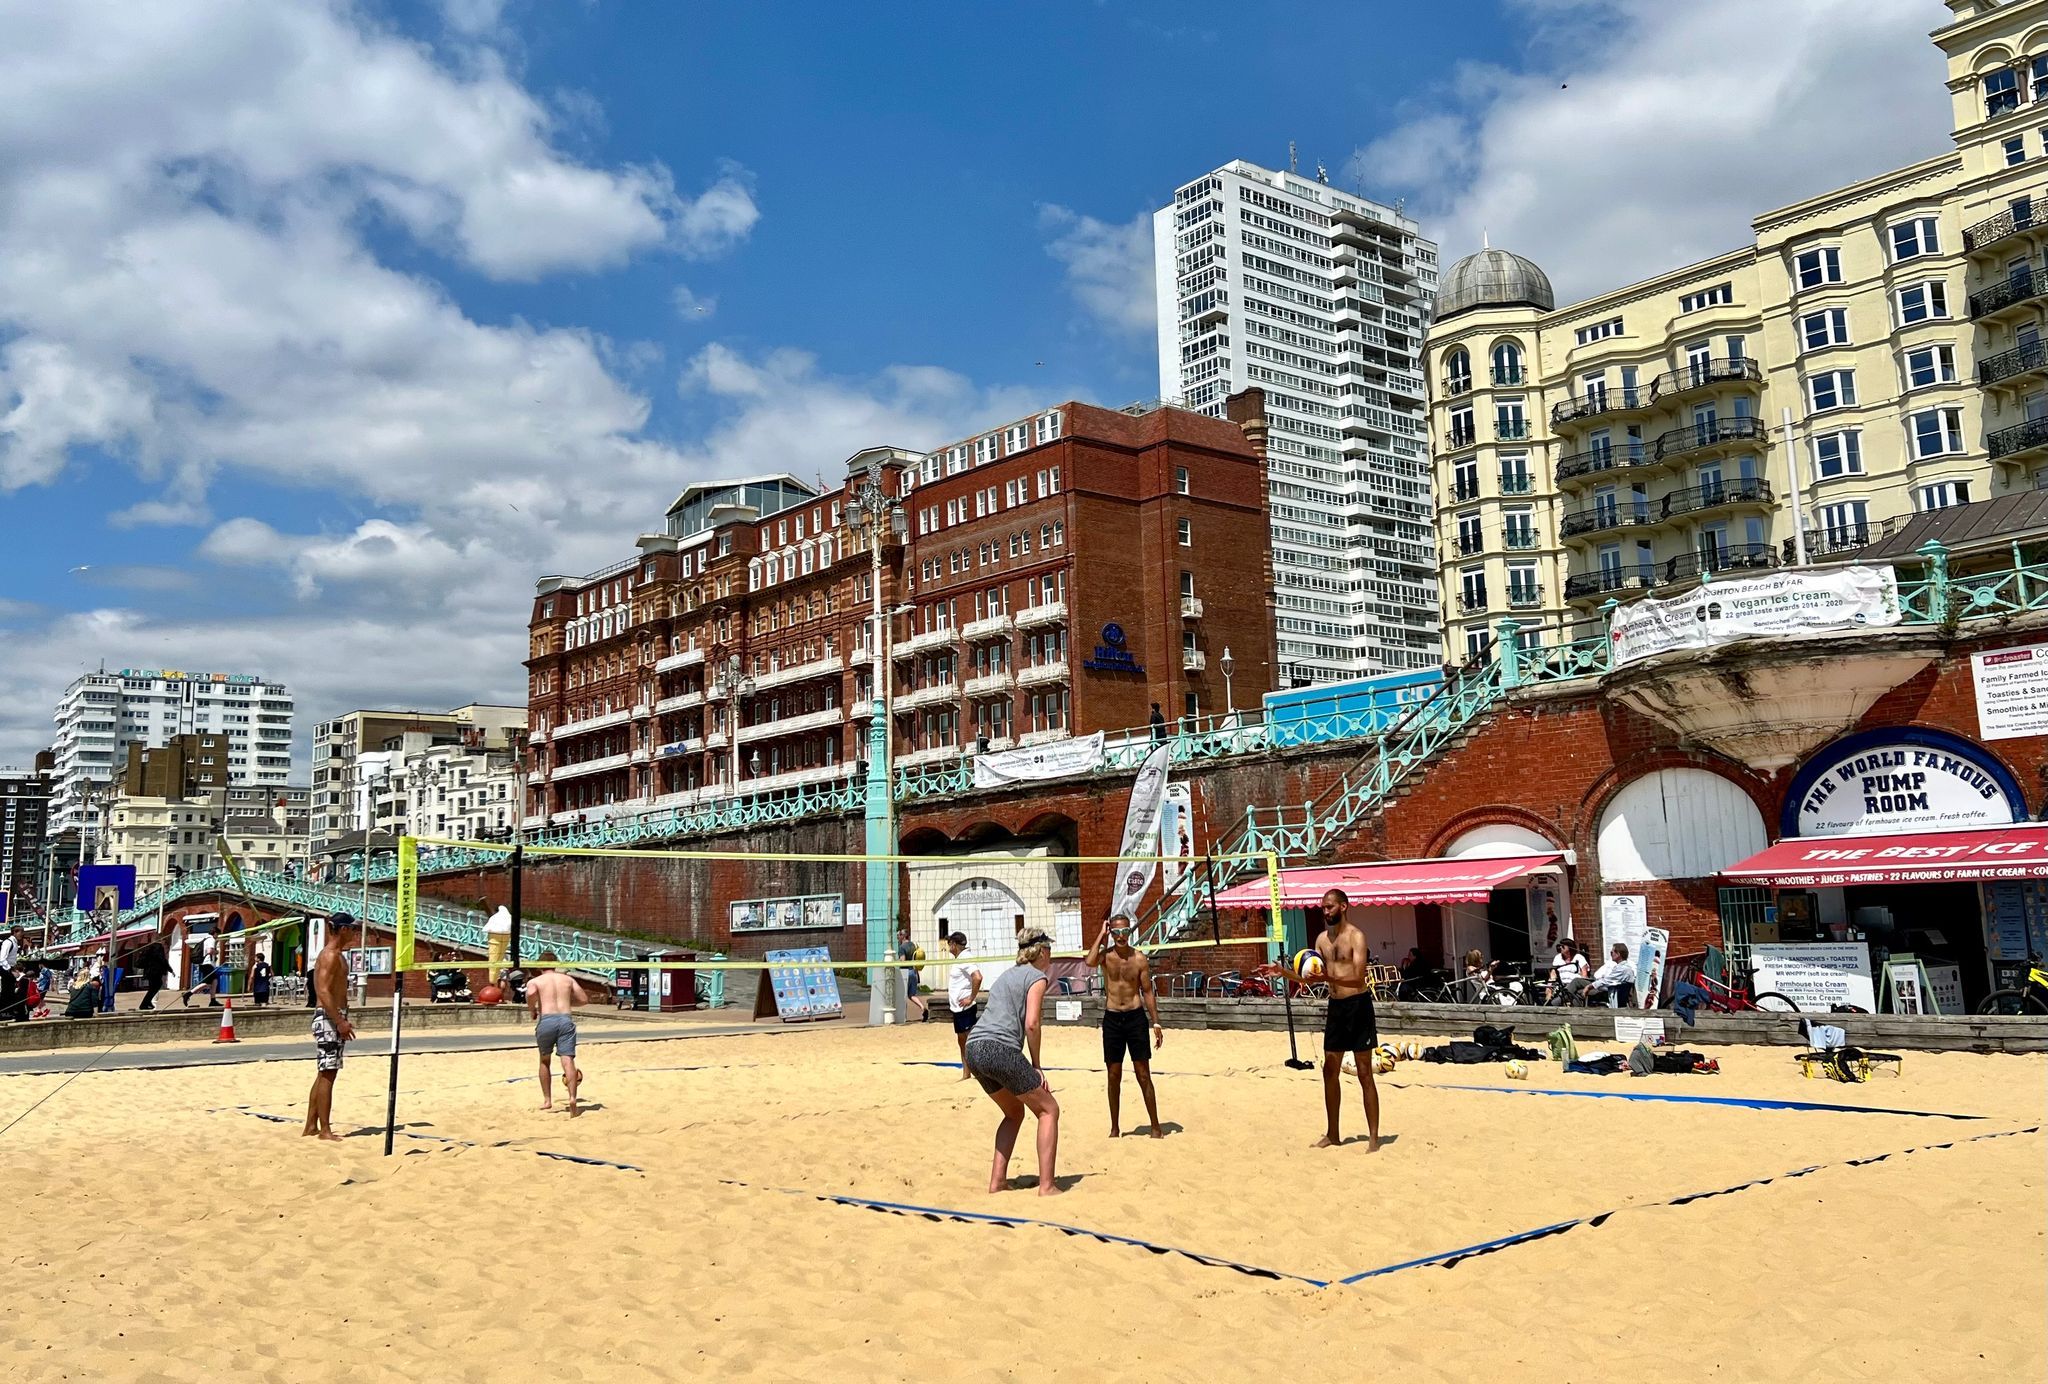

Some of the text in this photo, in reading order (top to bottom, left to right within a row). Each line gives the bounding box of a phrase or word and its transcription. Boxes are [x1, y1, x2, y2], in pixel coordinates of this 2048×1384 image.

[1741, 583, 1771, 594] BEACH
[1773, 580, 1785, 589] BY
[1786, 578, 1804, 587] FAR
[1732, 590, 1831, 610] Vegan Ice Cream
[1665, 611, 1692, 623] Cream
[1735, 610, 1754, 620] great
[1754, 606, 1773, 615] taste
[1774, 603, 1800, 613] awards
[1801, 601, 1819, 609] 2014
[1825, 599, 1844, 607] 2020
[1753, 618, 1791, 628] Sandwiches
[1094, 645, 1135, 662] Hilton
[1980, 676, 2007, 684] Family
[2008, 671, 2039, 680] Farmed
[1987, 689, 2020, 698] Toasties
[1986, 704, 2029, 715] Smoothies
[1803, 750, 1999, 815] THE WORLD FAMOUS
[1862, 771, 1927, 794] PUMP
[1864, 792, 1929, 815] ROOM
[1815, 810, 1988, 830] 22 flavours of farmhouse ice cream. Fresh coffee.
[1128, 829, 1158, 840] Vegan
[1123, 847, 1156, 857] Cream
[1133, 841, 1148, 849] Ice
[1800, 841, 2039, 861] THE BEST ICE
[1775, 876, 1815, 886] SMOOTHIES
[1820, 874, 1845, 885] JUICES
[1850, 872, 1884, 882] PASTRIES
[1889, 871, 1901, 881] 22
[1901, 870, 1942, 880] FLAVOURS
[1943, 868, 1955, 878] OF
[1956, 868, 1980, 878] FARM
[1981, 867, 1995, 877] ICE
[1996, 866, 2026, 877] CREAM
